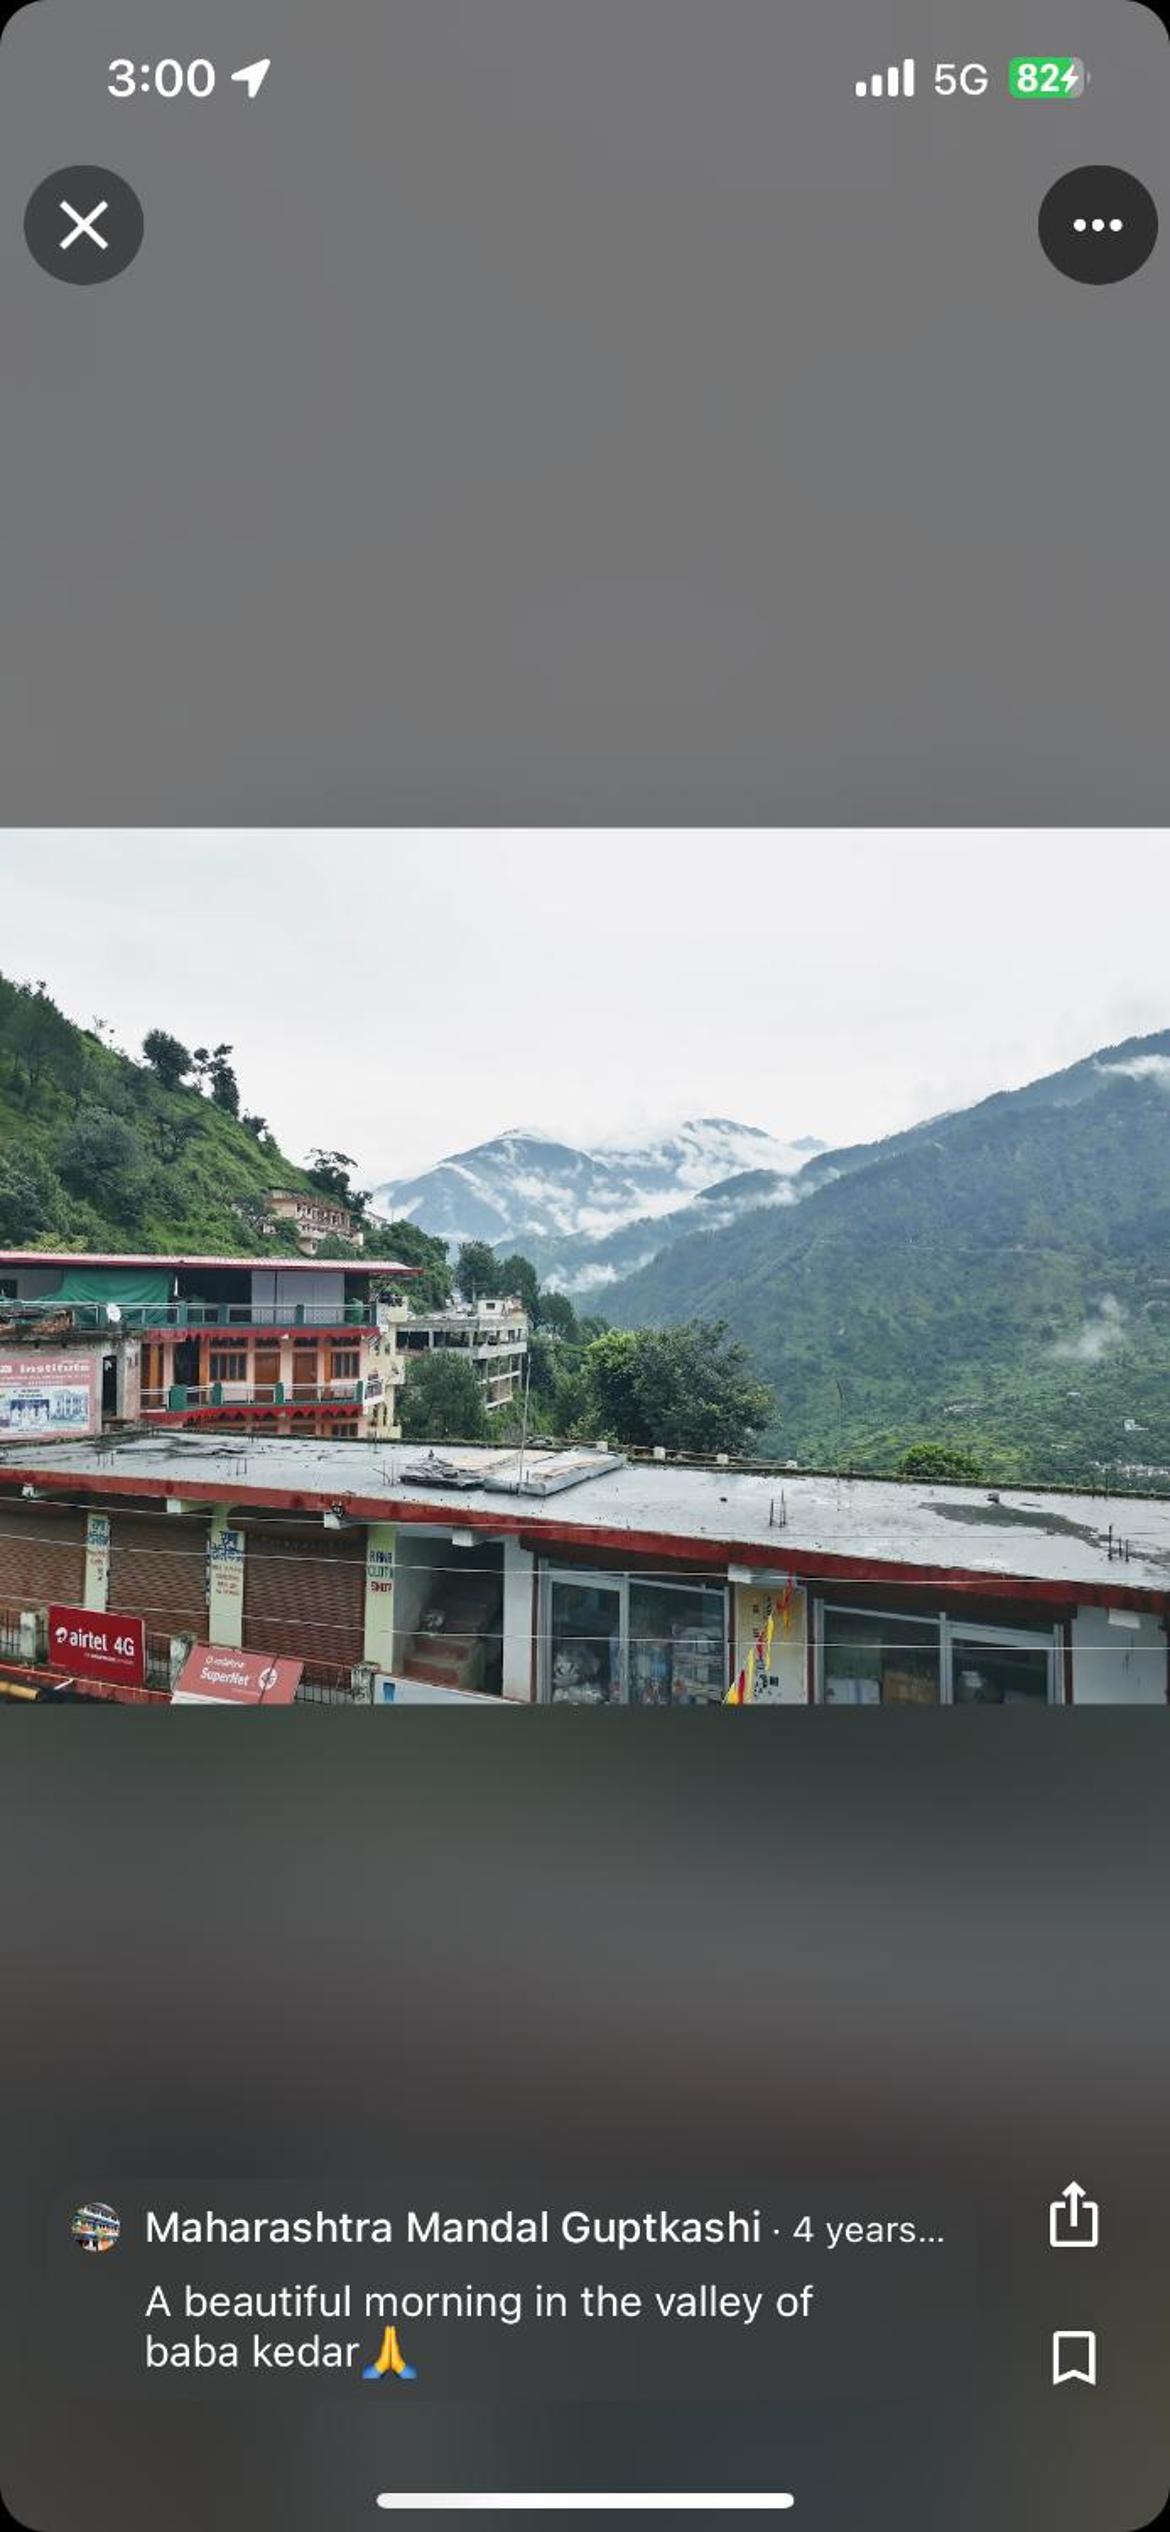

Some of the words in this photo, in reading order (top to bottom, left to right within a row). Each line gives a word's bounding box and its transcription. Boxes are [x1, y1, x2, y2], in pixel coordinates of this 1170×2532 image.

[69, 1628, 108, 1652] airtel
[114, 1636, 135, 1657] 4G
[200, 1667, 249, 1686] SuperNet
